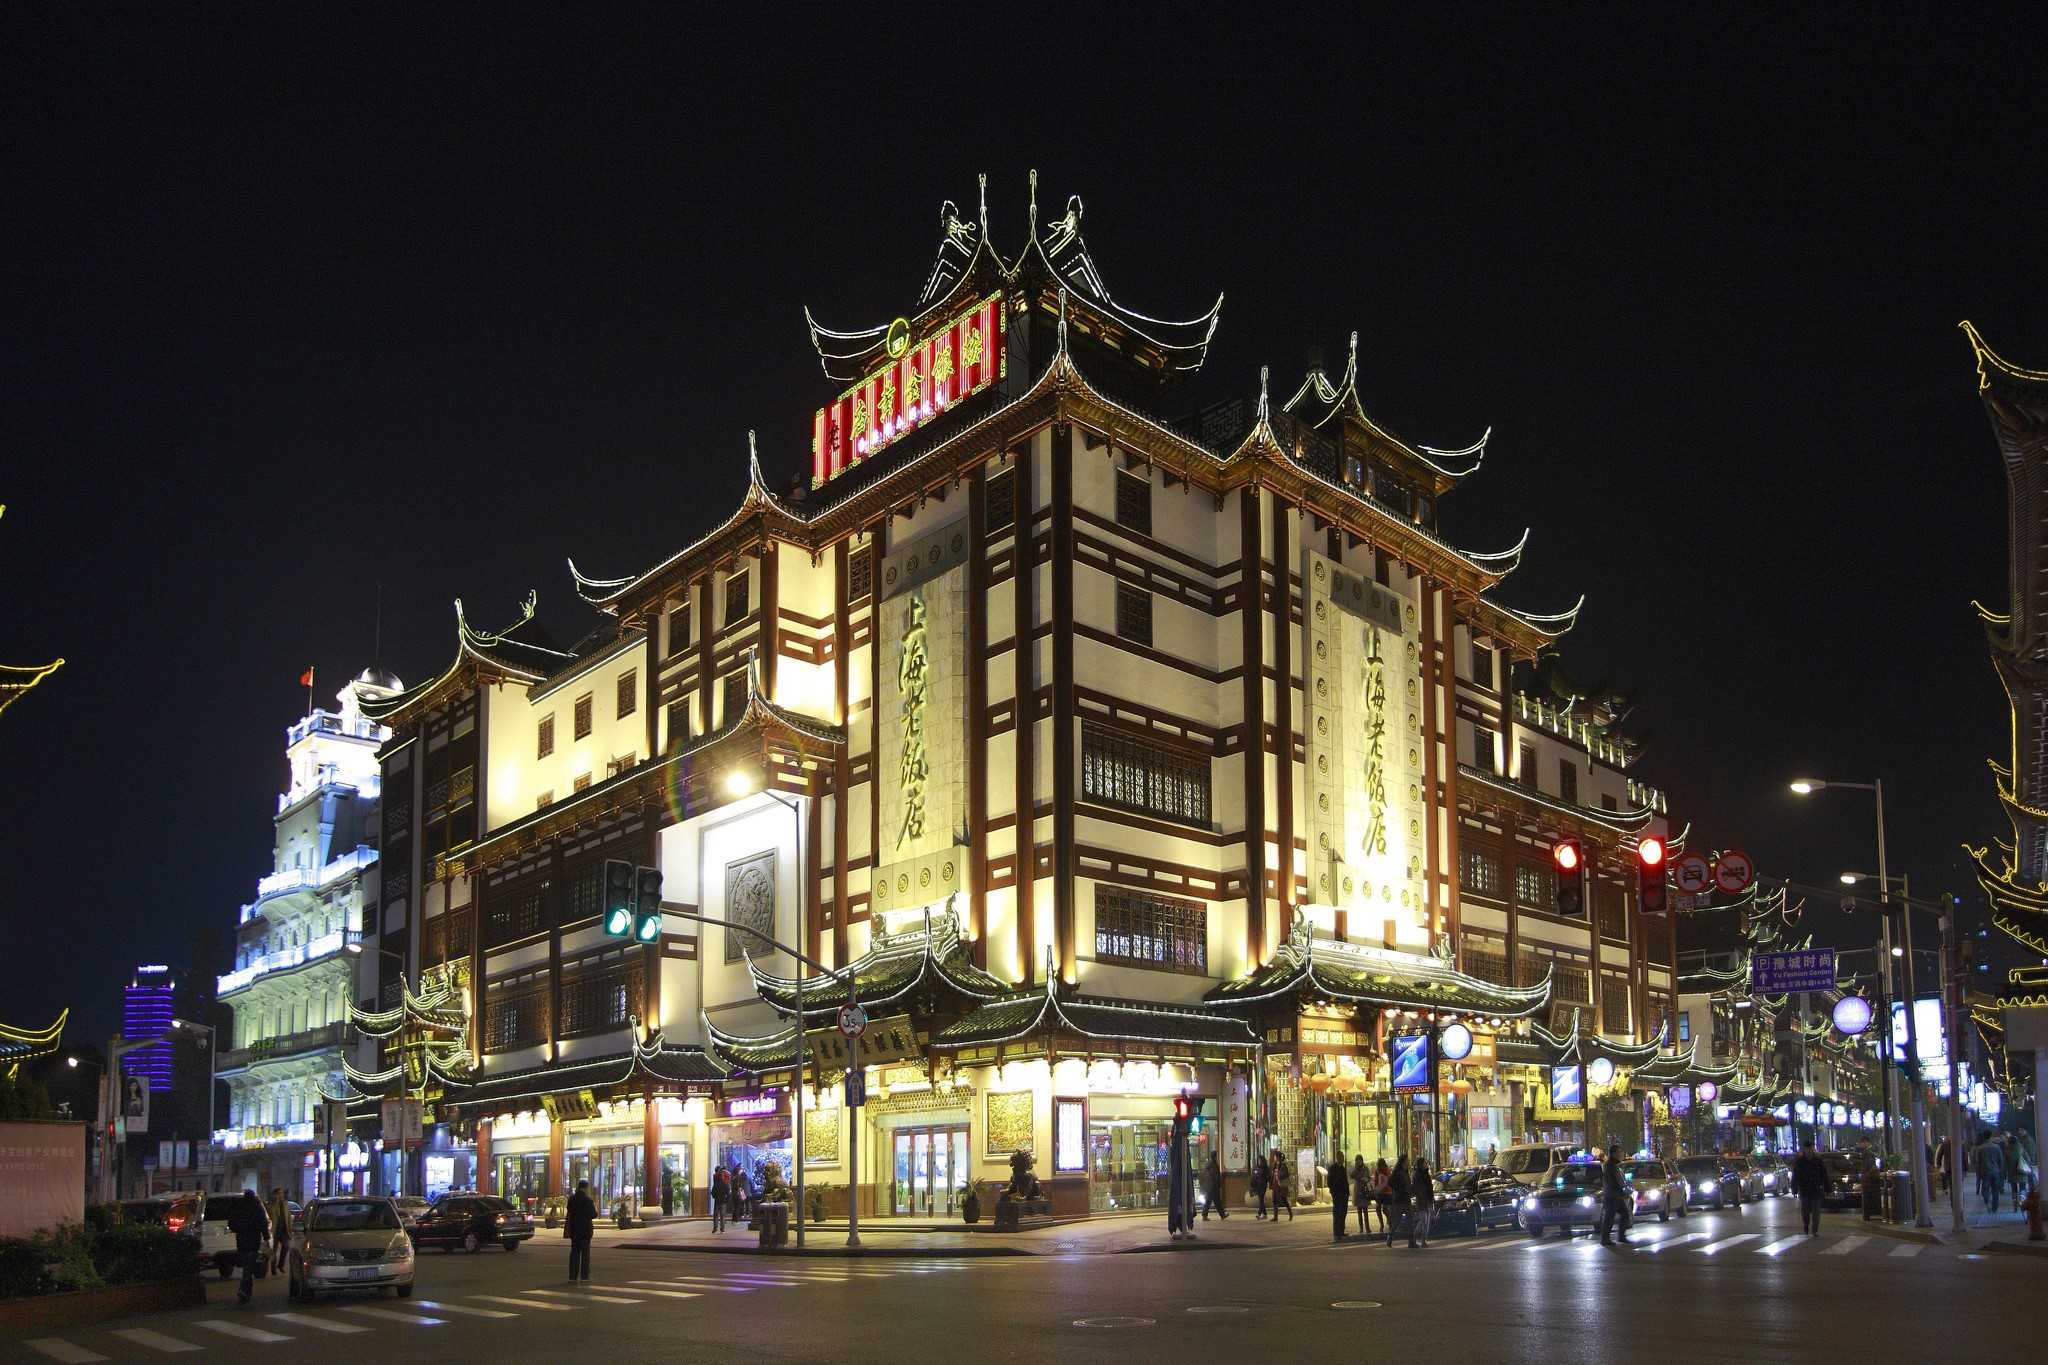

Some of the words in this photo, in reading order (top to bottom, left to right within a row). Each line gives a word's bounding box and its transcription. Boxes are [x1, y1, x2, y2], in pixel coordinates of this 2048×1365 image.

[1773, 953, 1831, 970] 豫城时尚
[1783, 970, 1808, 978] Fashion
[1809, 968, 1832, 976] Garden
[843, 1013, 863, 1028] 3.5m
[1555, 1009, 1590, 1032] 聚堂
[27, 1162, 45, 1170] 2012
